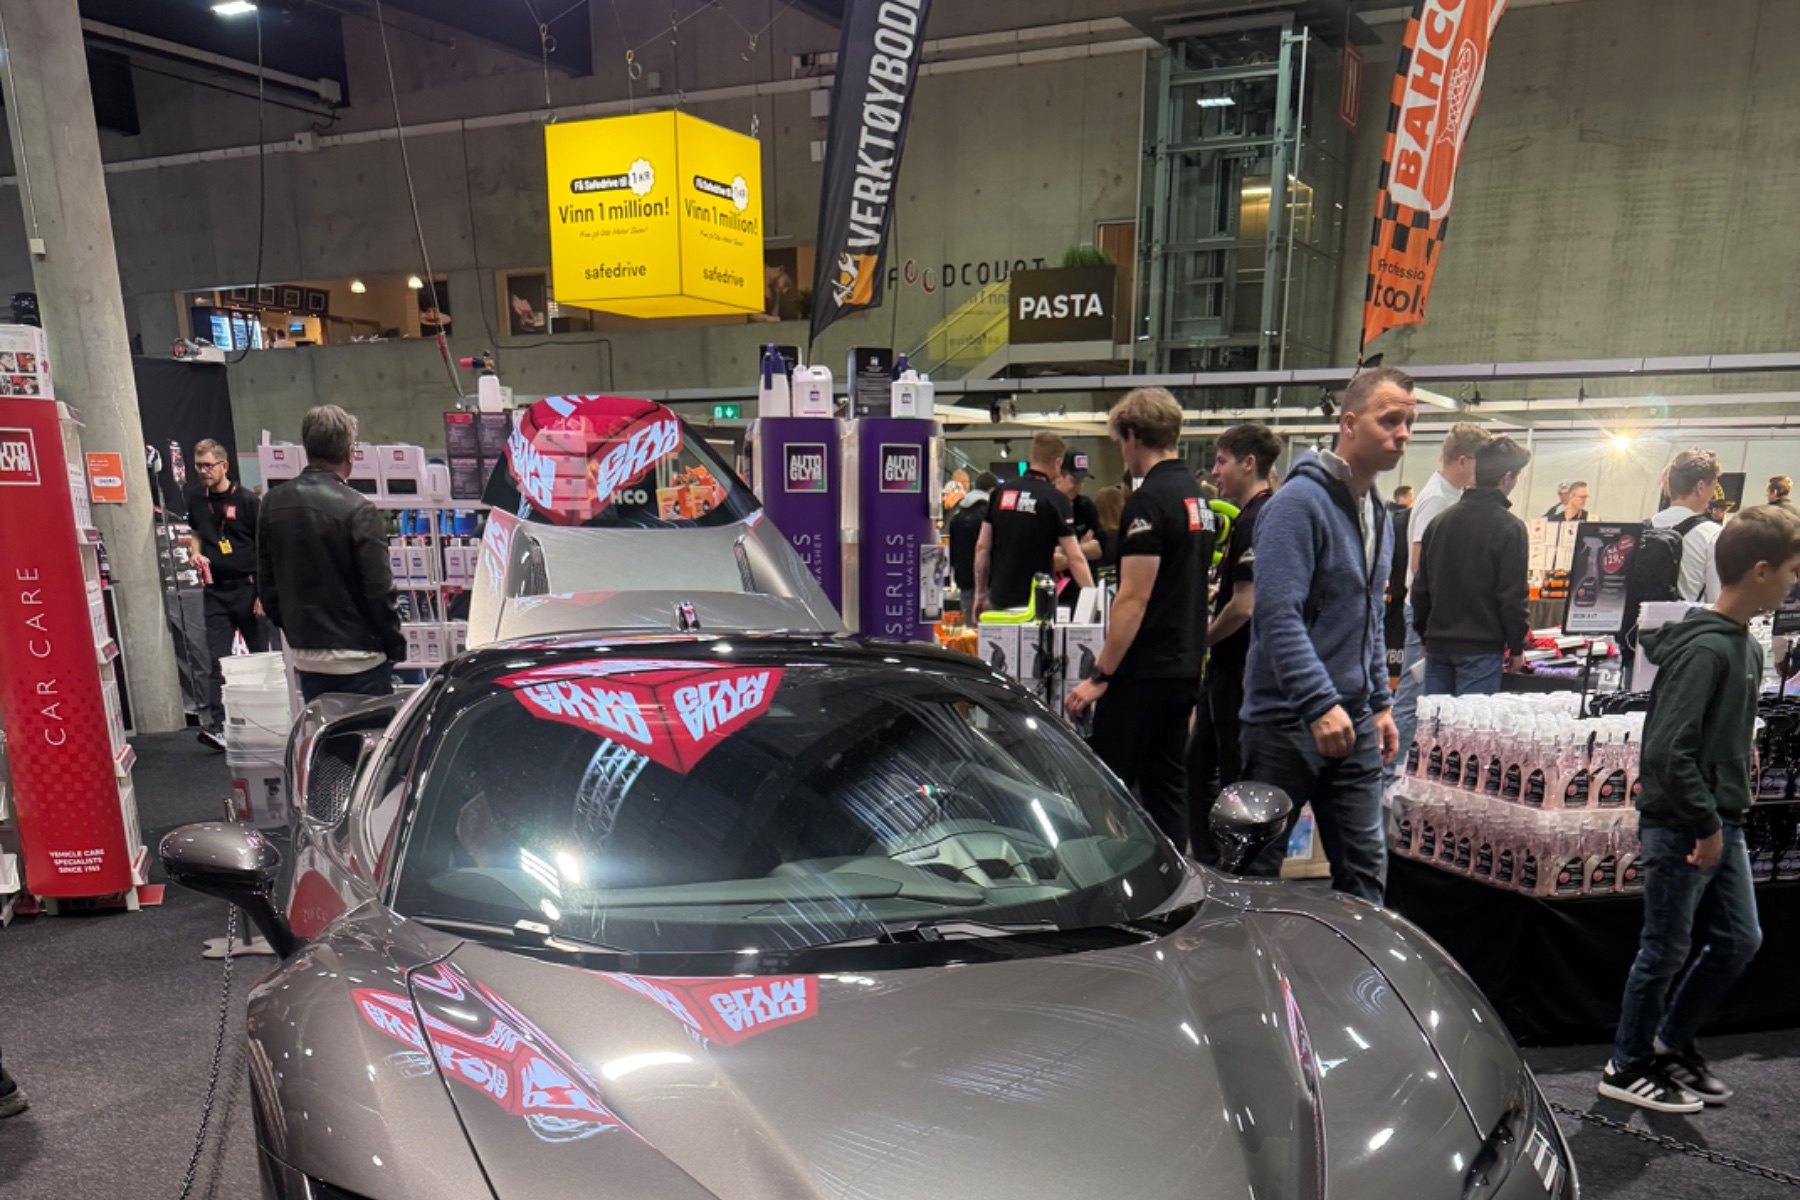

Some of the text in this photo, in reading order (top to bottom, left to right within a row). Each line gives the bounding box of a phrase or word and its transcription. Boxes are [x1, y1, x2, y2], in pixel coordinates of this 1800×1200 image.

[559, 196, 670, 224] Vinn 1 million!
[684, 198, 759, 236] Vinn 1 million!
[584, 261, 647, 280] safedrive
[703, 266, 744, 287] safedrive
[1019, 293, 1104, 320] PASTA
[790, 455, 822, 468] AUTO
[885, 455, 917, 468] AUTO
[790, 467, 822, 481] GLYM
[885, 467, 917, 481] GLYM
[906, 534, 915, 586] WASHER
[886, 534, 904, 634] SERIES
[17, 567, 67, 746] CAR CARE
[49, 850, 82, 858] VEHICLE
[54, 857, 103, 866] SPECIALISTS
